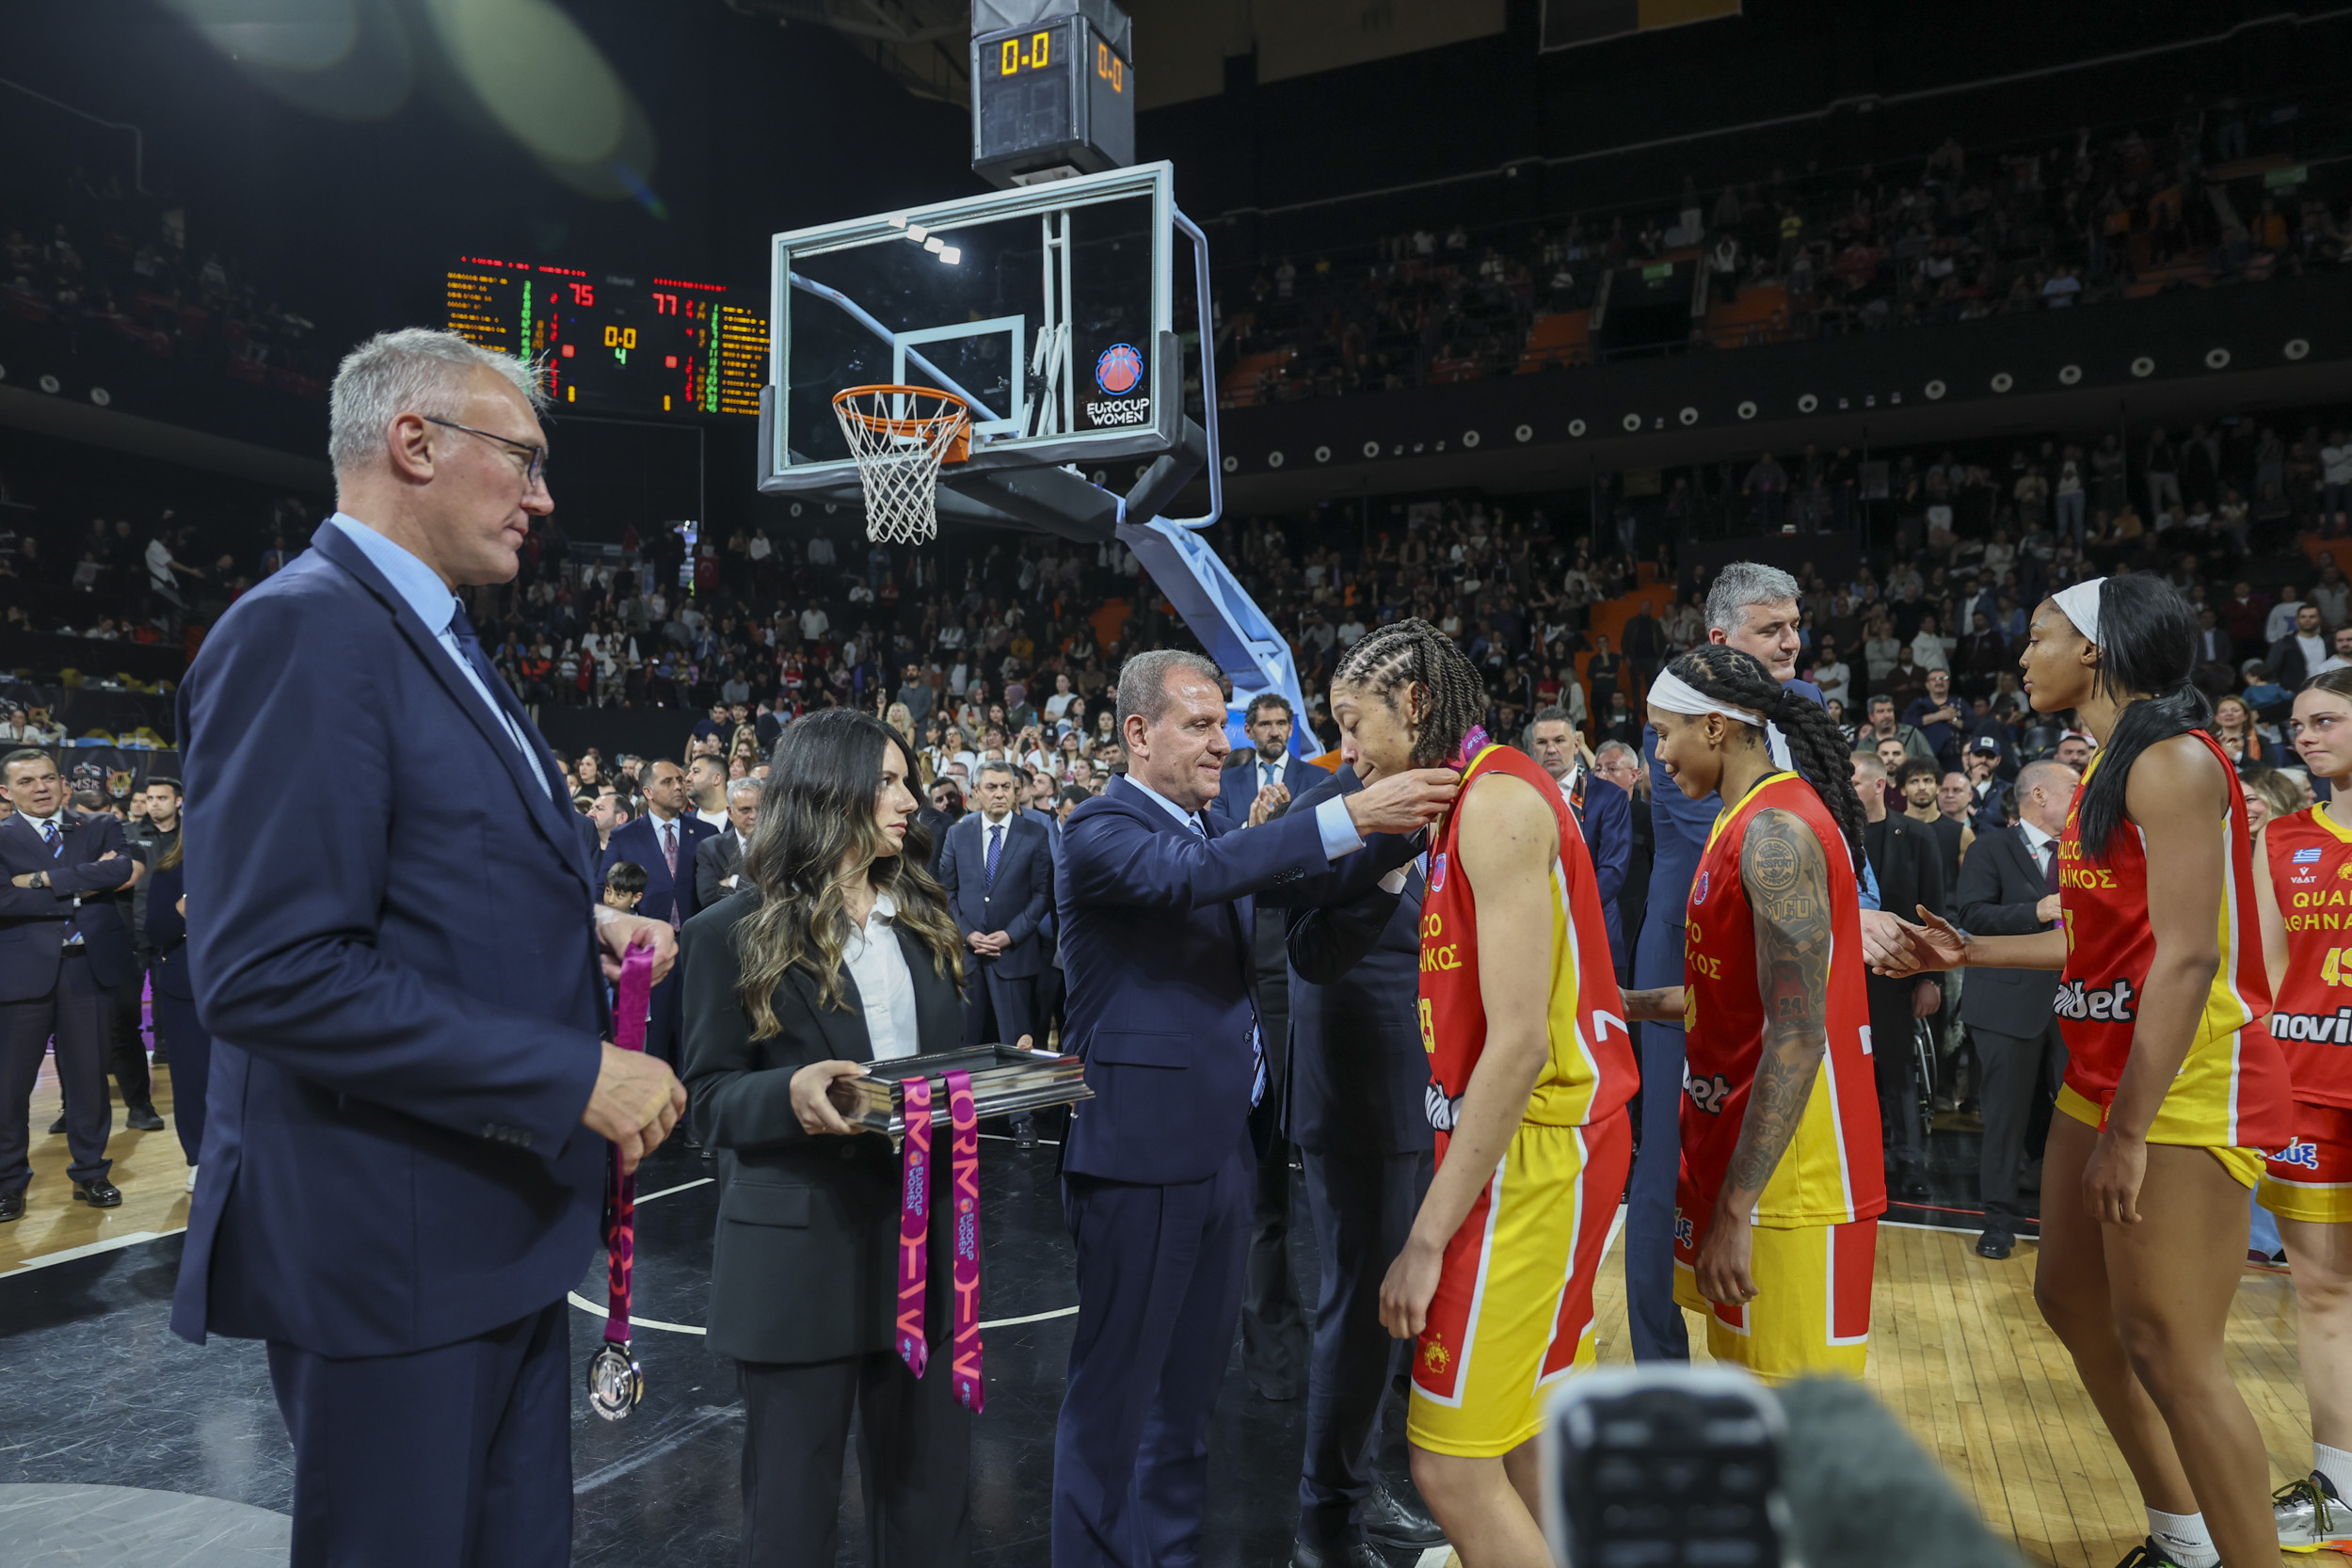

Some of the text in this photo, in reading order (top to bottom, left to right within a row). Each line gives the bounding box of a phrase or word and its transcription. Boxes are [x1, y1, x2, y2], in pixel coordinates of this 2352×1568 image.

[568, 282, 595, 307] 75
[652, 292, 678, 316] 77
[615, 347, 627, 365] 4
[1087, 398, 1150, 415] EUROCUP
[1091, 410, 1144, 425] WOMEN
[1755, 857, 1794, 871] PASSPORT
[2290, 875, 2317, 885] VAAT
[2271, 1008, 2352, 1044] novi
